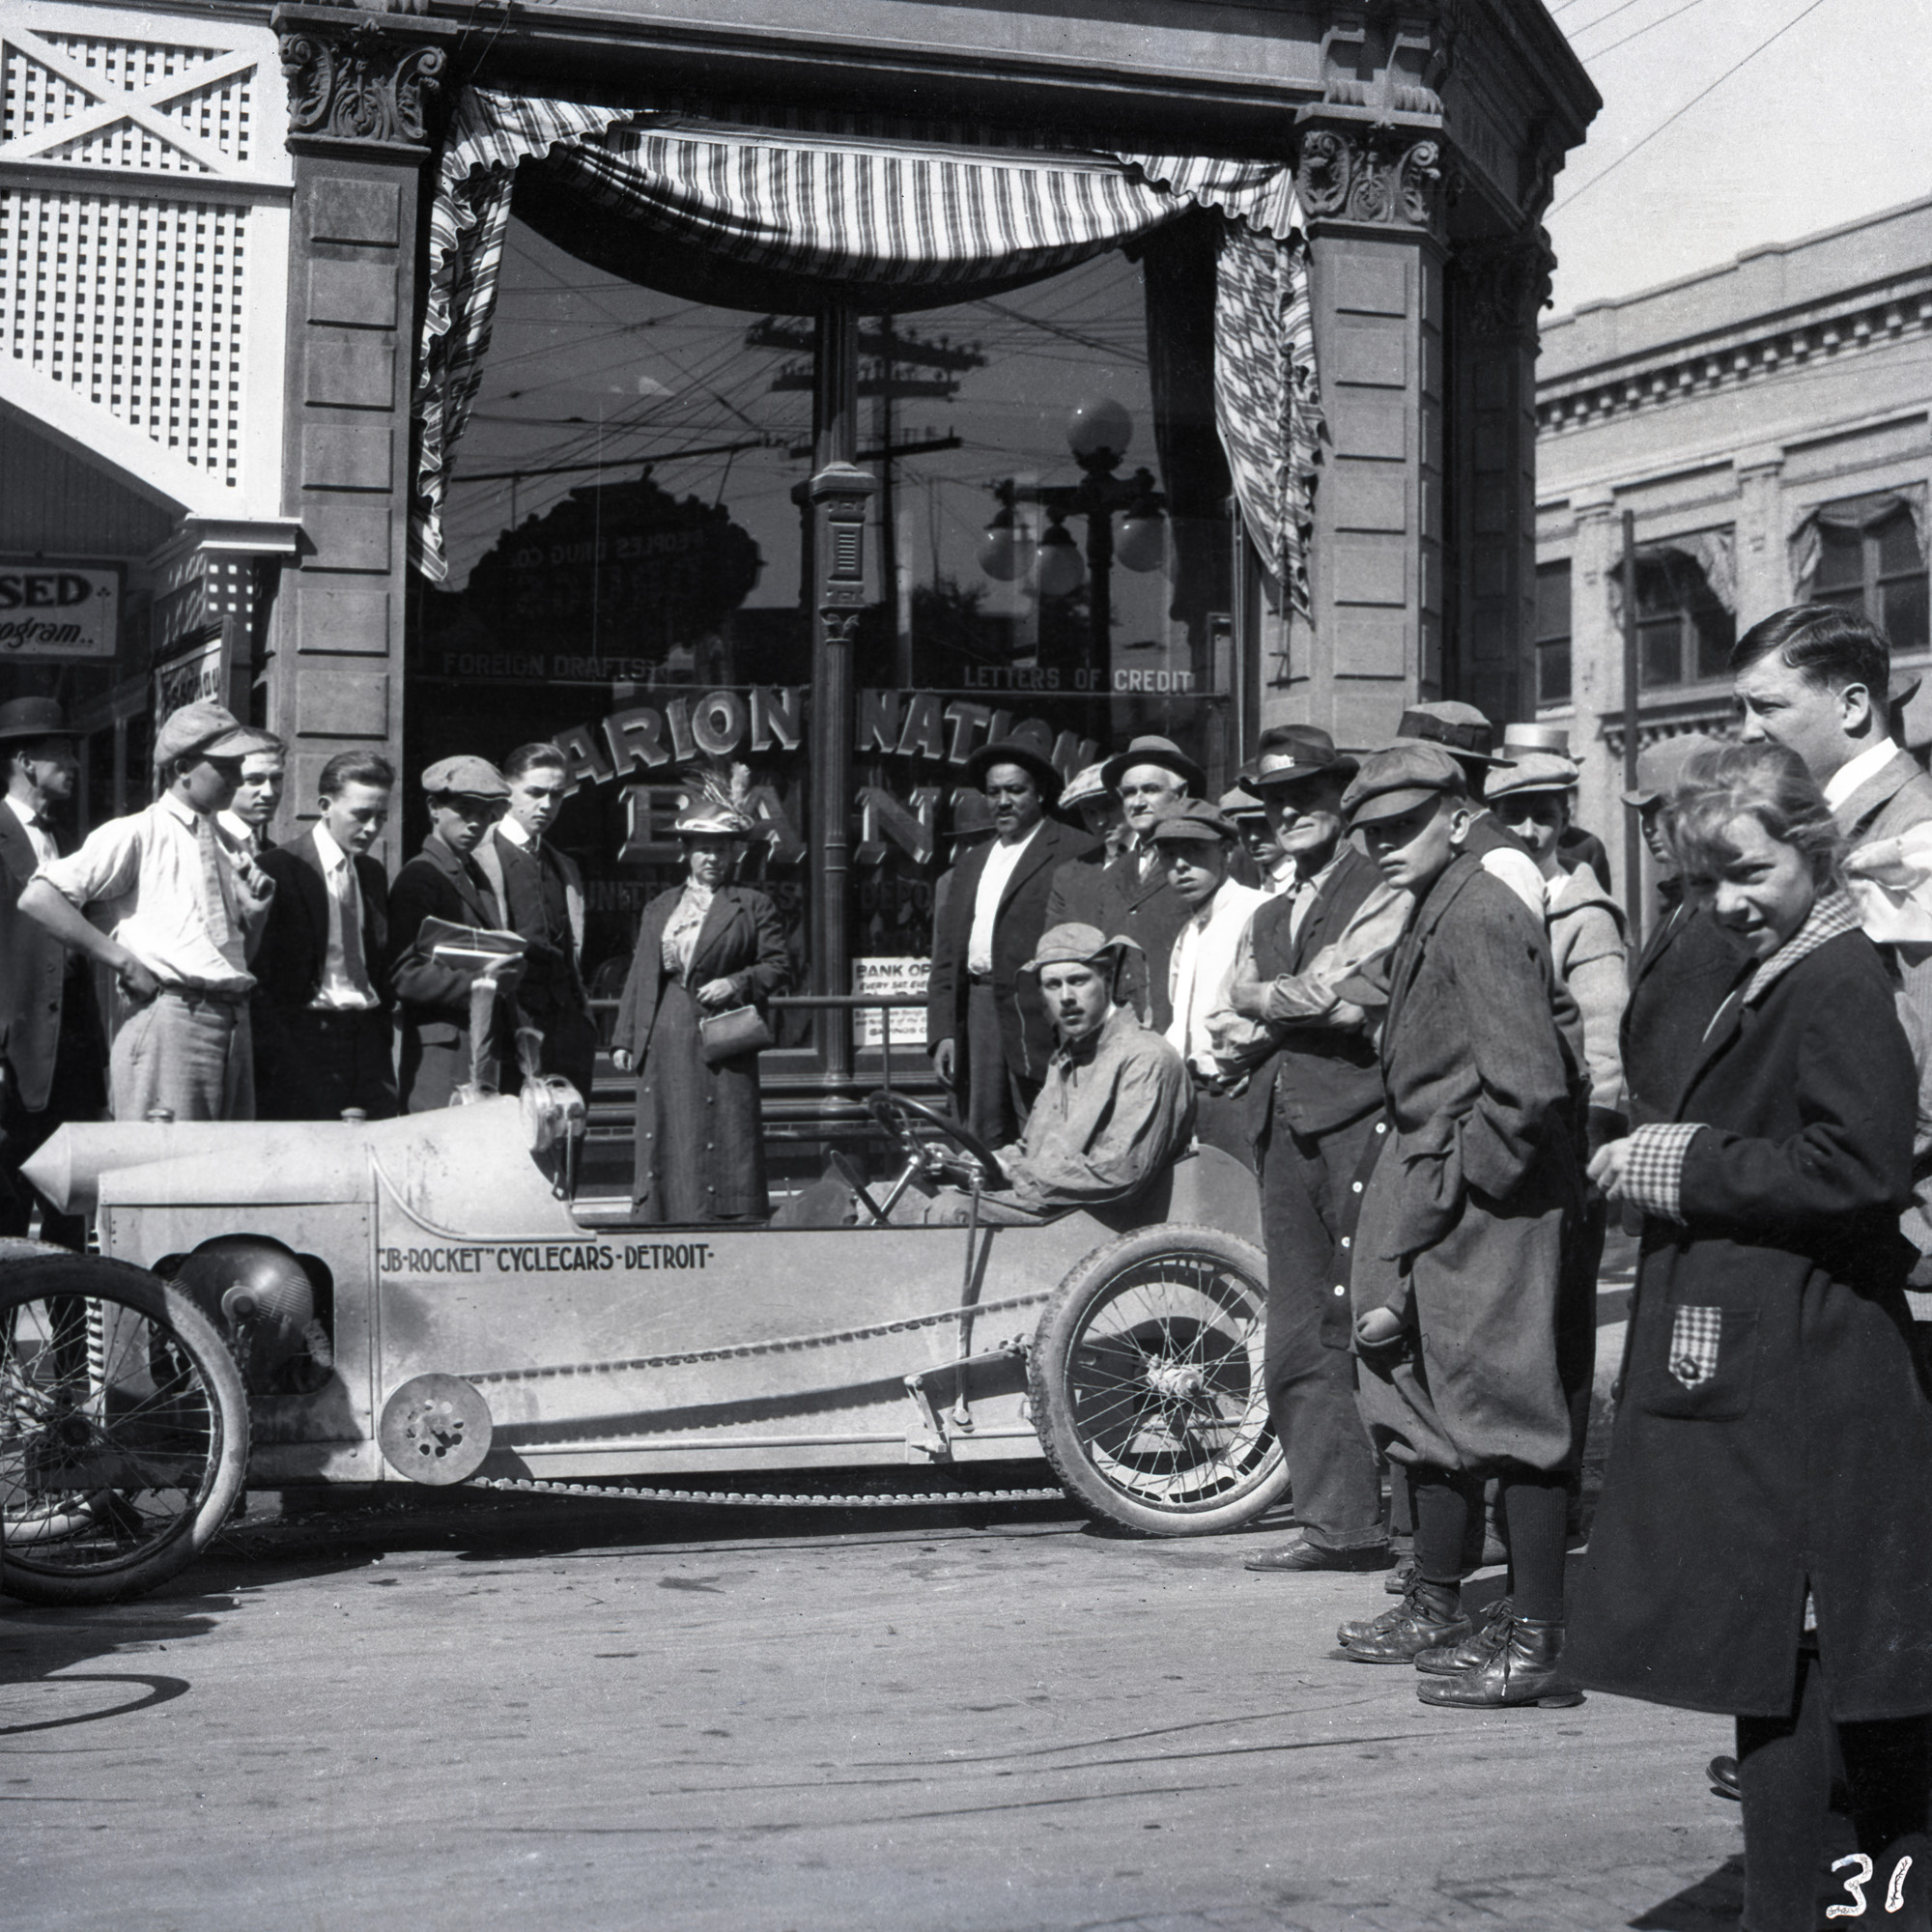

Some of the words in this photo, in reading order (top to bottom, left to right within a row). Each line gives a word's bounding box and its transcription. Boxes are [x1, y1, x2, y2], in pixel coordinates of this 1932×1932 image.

[442, 653, 545, 676] FOREIGN
[553, 656, 647, 678] DRAFTS
[964, 666, 1060, 689] LETTERS
[1074, 668, 1101, 690] OF
[1114, 669, 1194, 692] CREDIT
[552, 686, 803, 798] ARION
[860, 880, 933, 911] DEPO
[856, 964, 903, 979] BANK
[859, 981, 889, 991] EVERY
